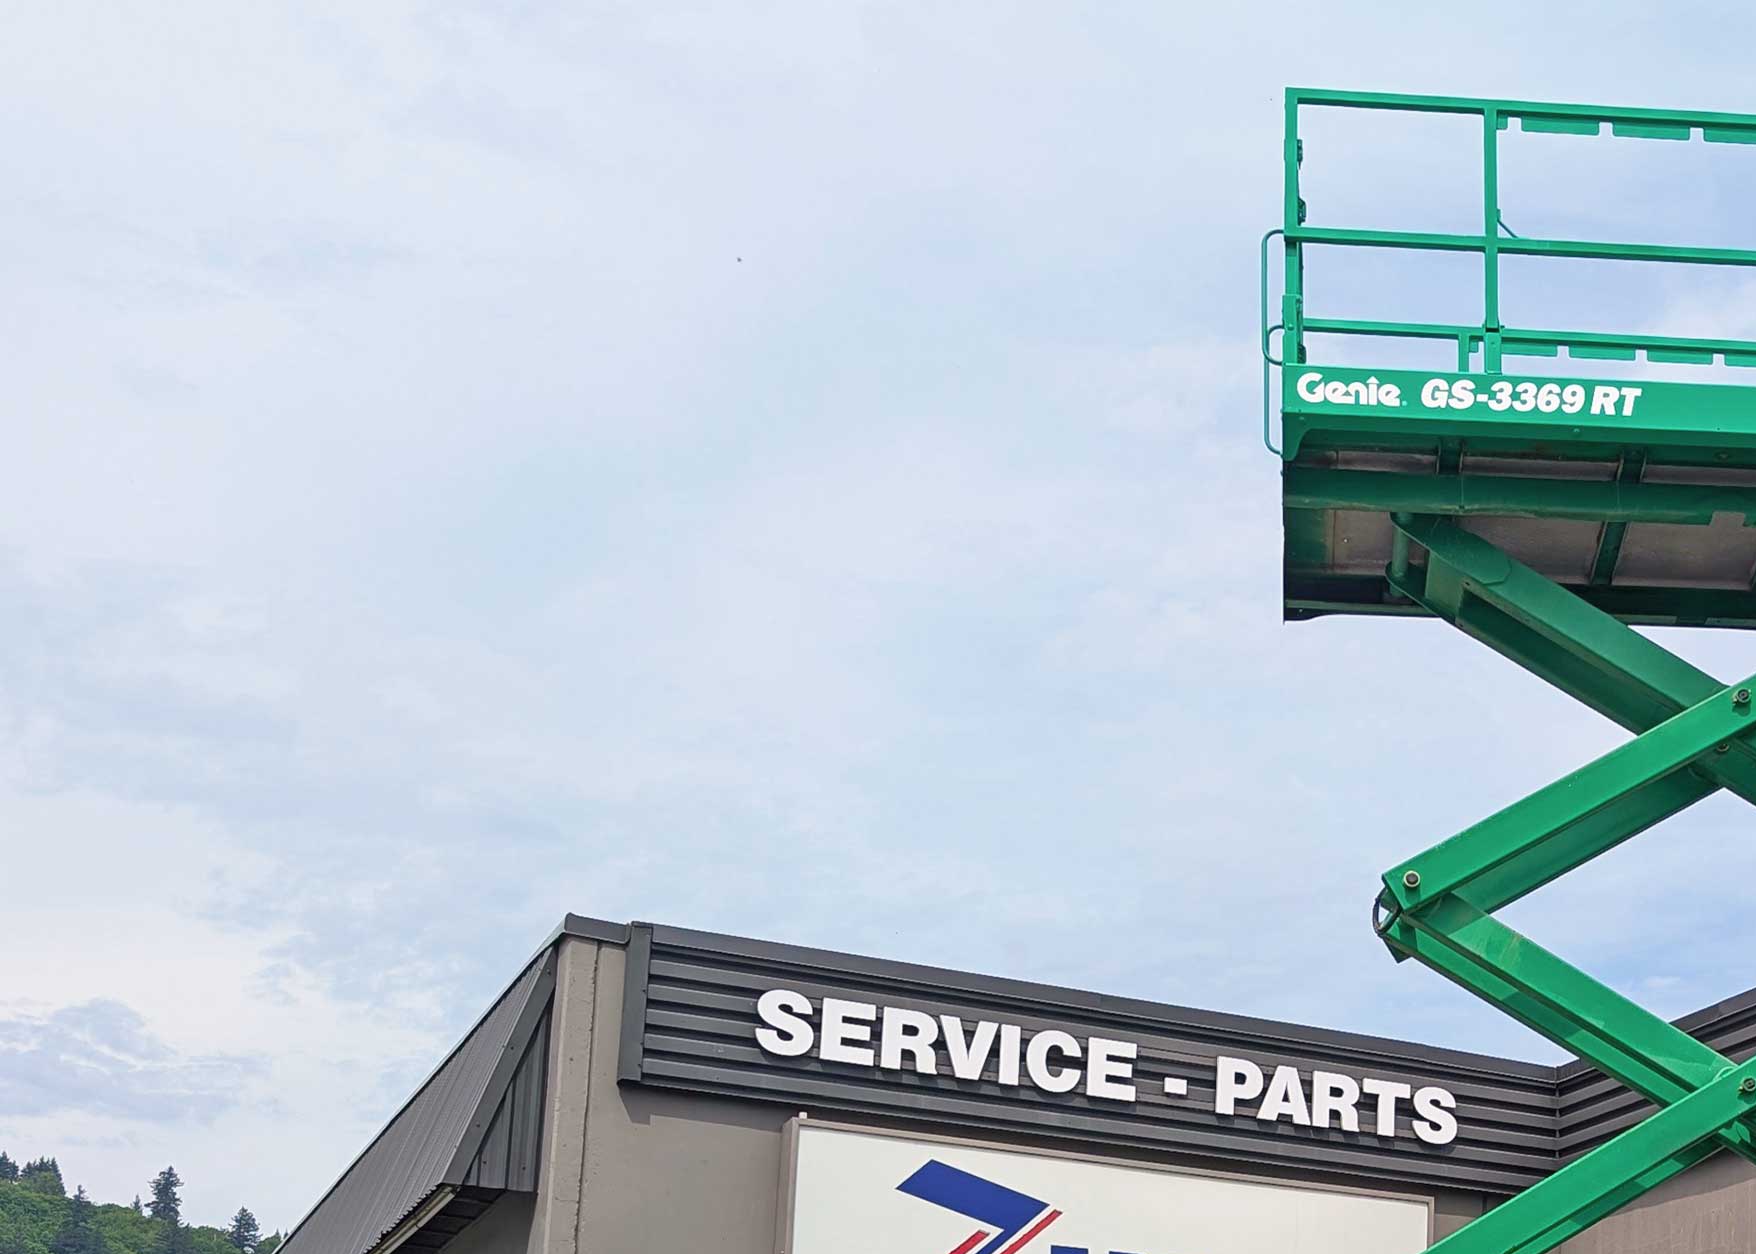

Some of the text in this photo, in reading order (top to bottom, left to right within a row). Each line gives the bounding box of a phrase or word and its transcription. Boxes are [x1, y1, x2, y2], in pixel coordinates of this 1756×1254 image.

[1297, 372, 1642, 417] Genie GS-3369 RT
[755, 988, 1138, 1102] SERVICE
[1215, 1055, 1458, 1145] PARTS
